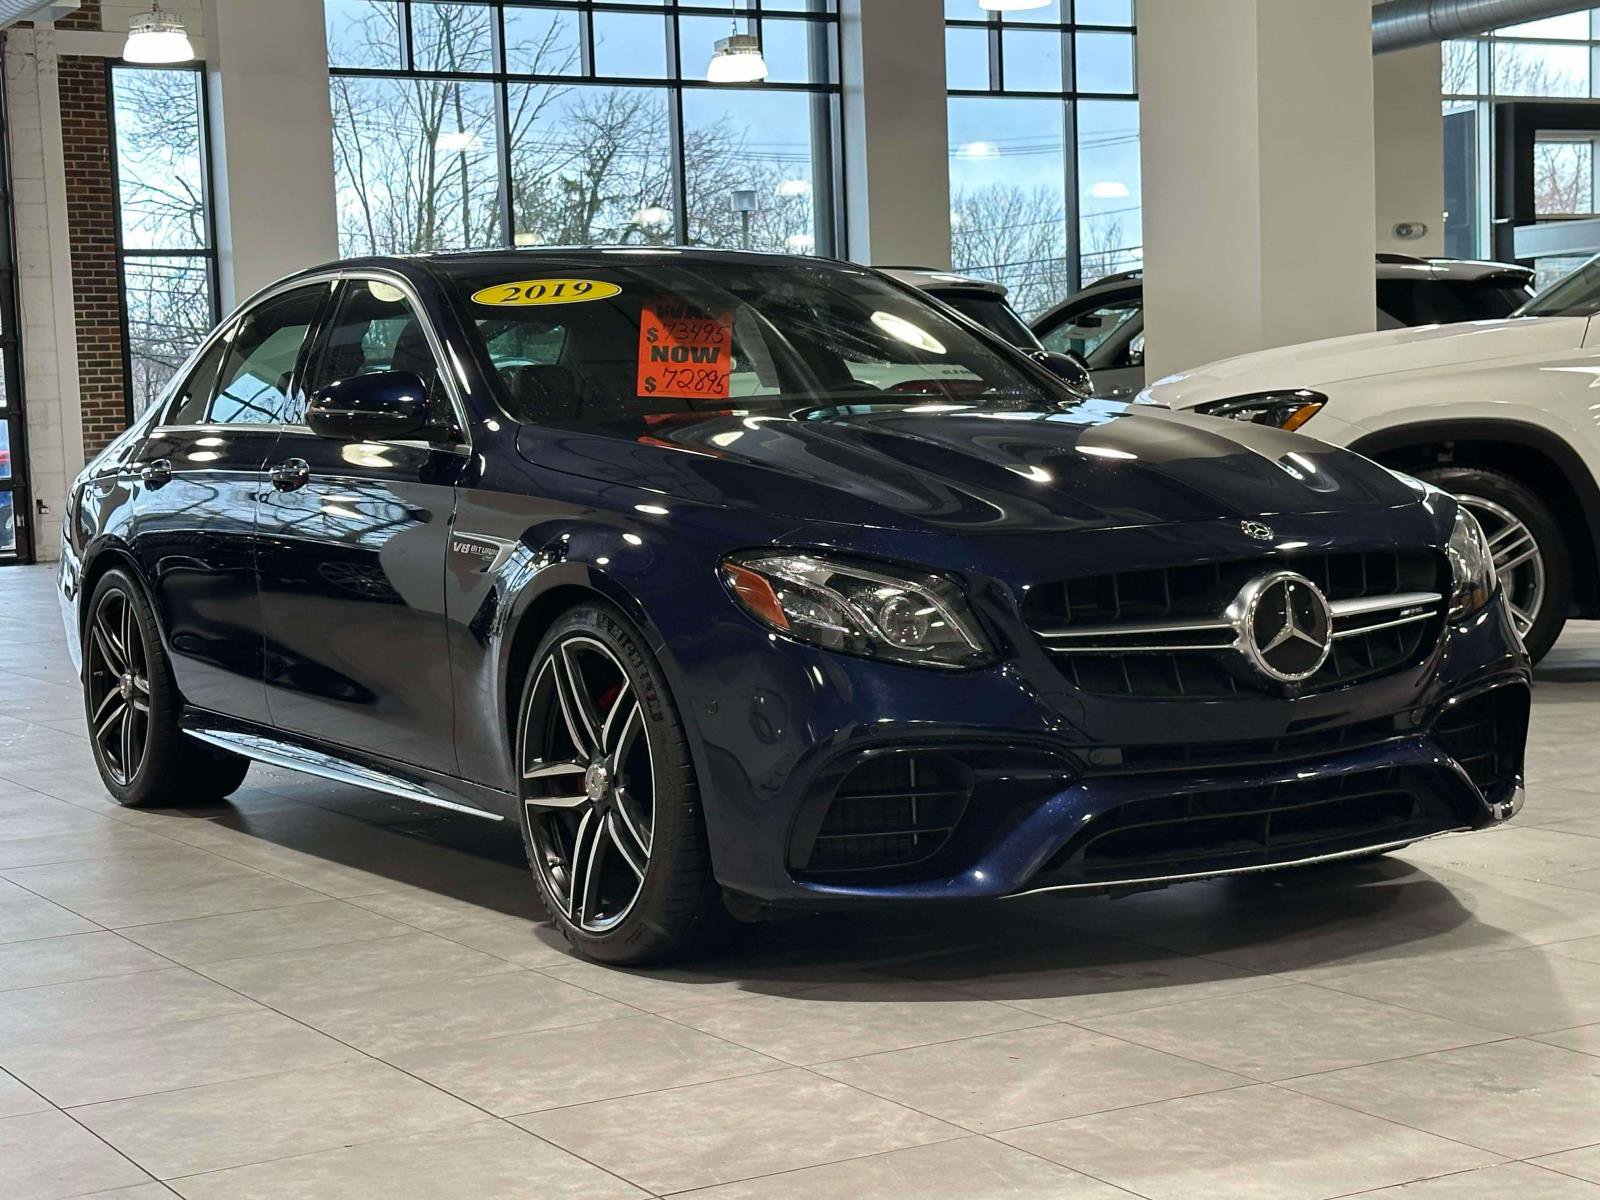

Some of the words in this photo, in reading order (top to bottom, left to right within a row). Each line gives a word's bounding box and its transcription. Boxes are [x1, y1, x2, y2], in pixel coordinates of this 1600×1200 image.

[500, 281, 594, 302] 2019
[650, 345, 720, 364] NOW
[663, 367, 732, 394] 72895
[453, 541, 471, 554] V8
